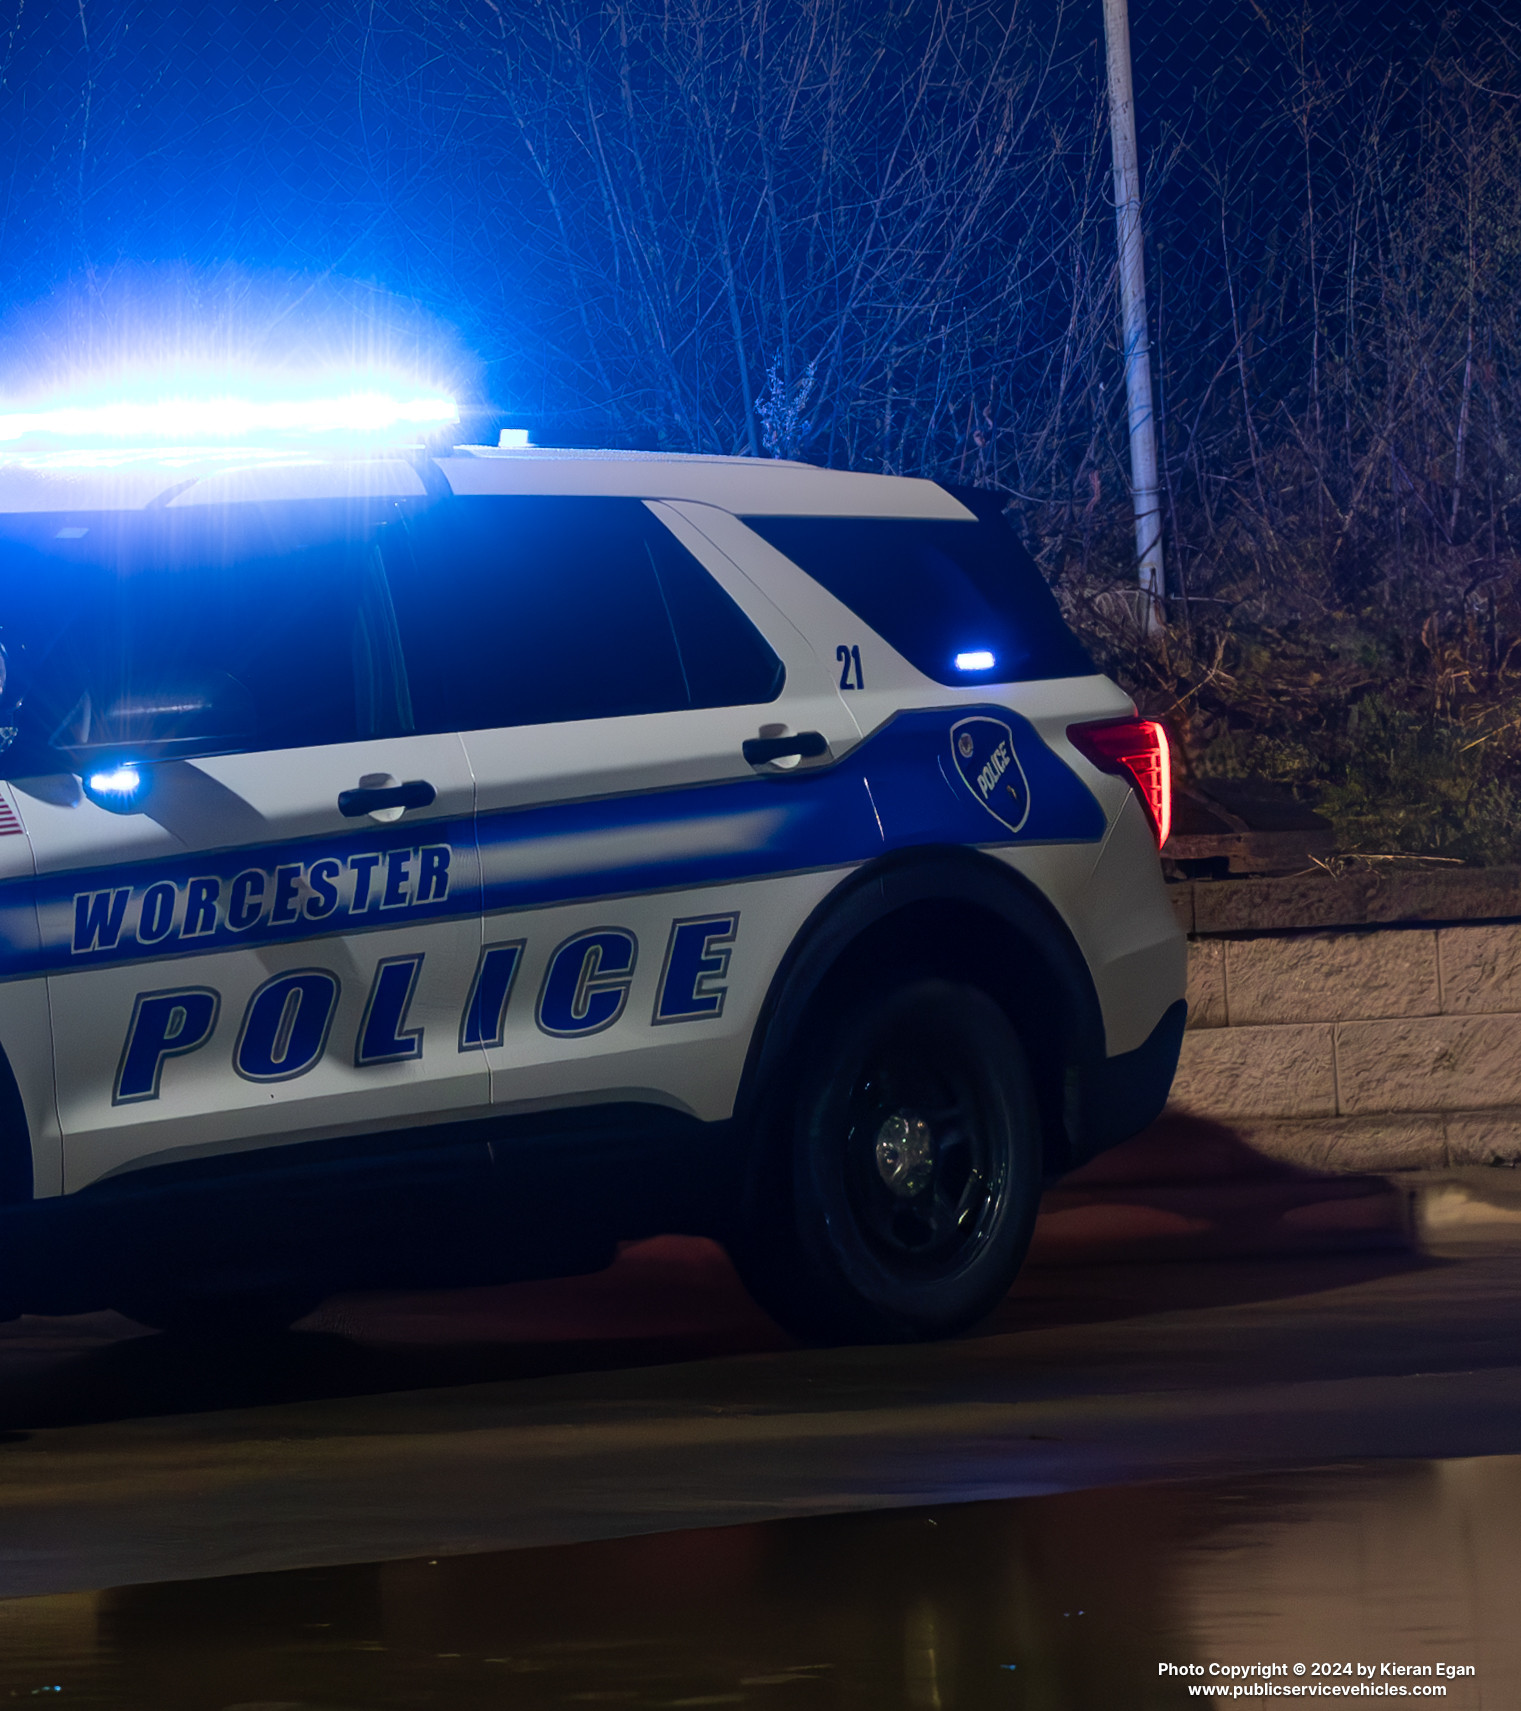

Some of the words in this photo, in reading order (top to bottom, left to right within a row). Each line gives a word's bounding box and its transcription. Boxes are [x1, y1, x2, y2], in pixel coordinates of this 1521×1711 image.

[836, 645, 864, 690] 21
[977, 741, 1011, 799] POLICE
[71, 844, 453, 953] WORCESTER
[112, 911, 740, 1106] POLICE
